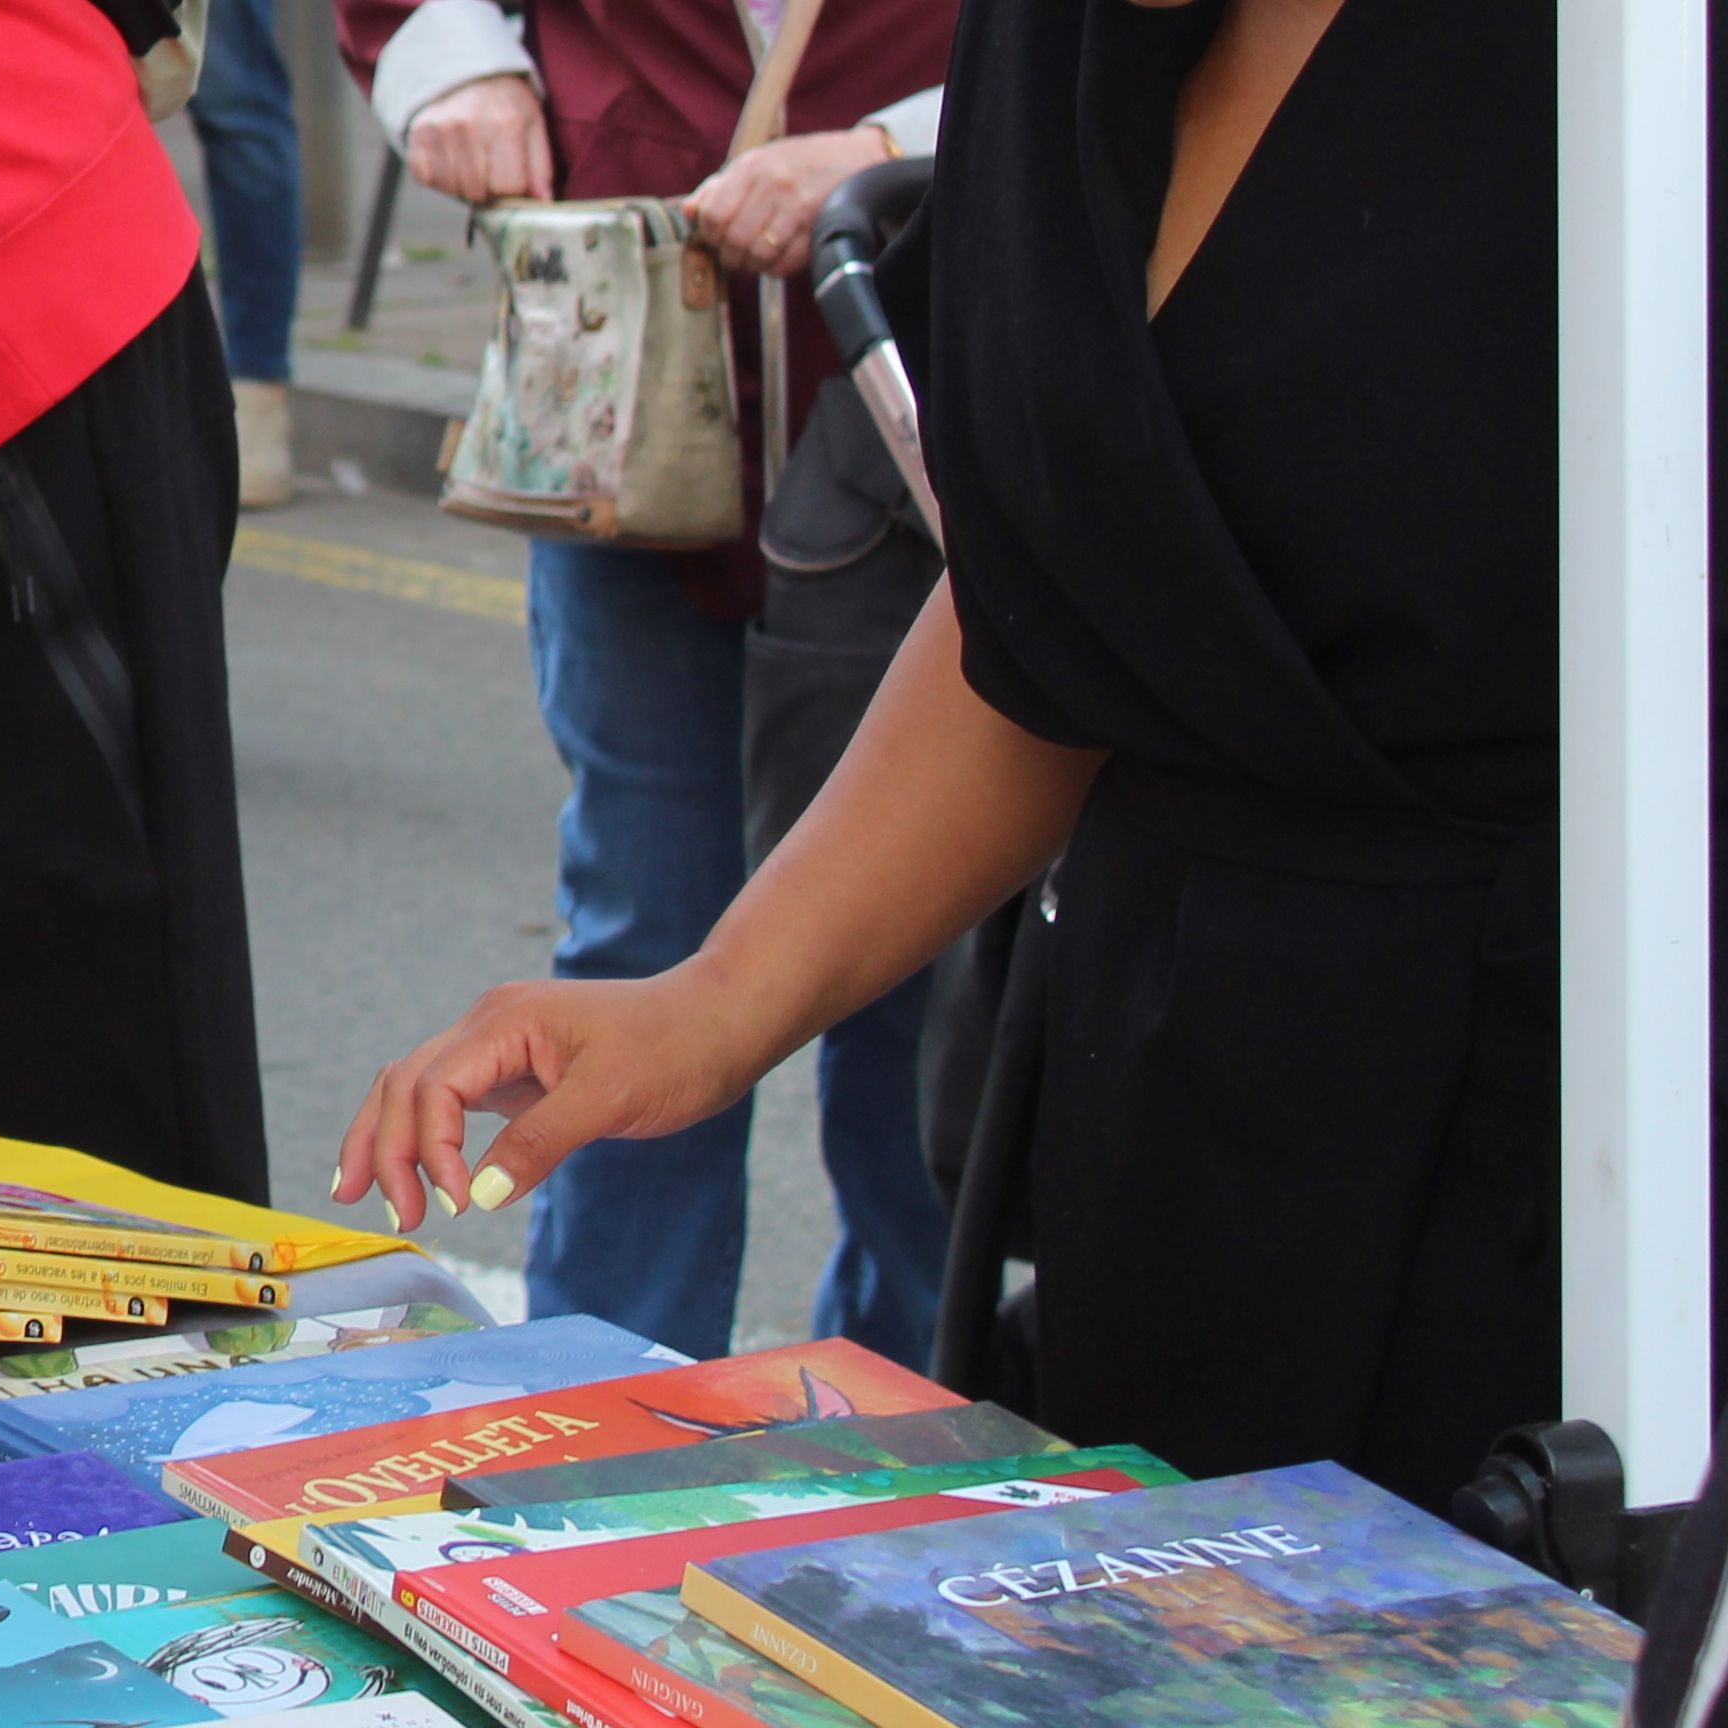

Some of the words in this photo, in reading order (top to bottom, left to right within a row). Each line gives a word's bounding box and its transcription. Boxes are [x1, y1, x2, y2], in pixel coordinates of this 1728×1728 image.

[15, 1261, 67, 1279] vacances
[11, 1288, 26, 1302] de
[31, 1289, 56, 1304] caso
[937, 1524, 1321, 1609] CÉZANNE
[419, 1600, 464, 1640] EIXERITS
[471, 1638, 508, 1671] PETITS
[750, 1622, 818, 1673] CÉZANNE
[630, 1665, 704, 1720] GAUGUIN
